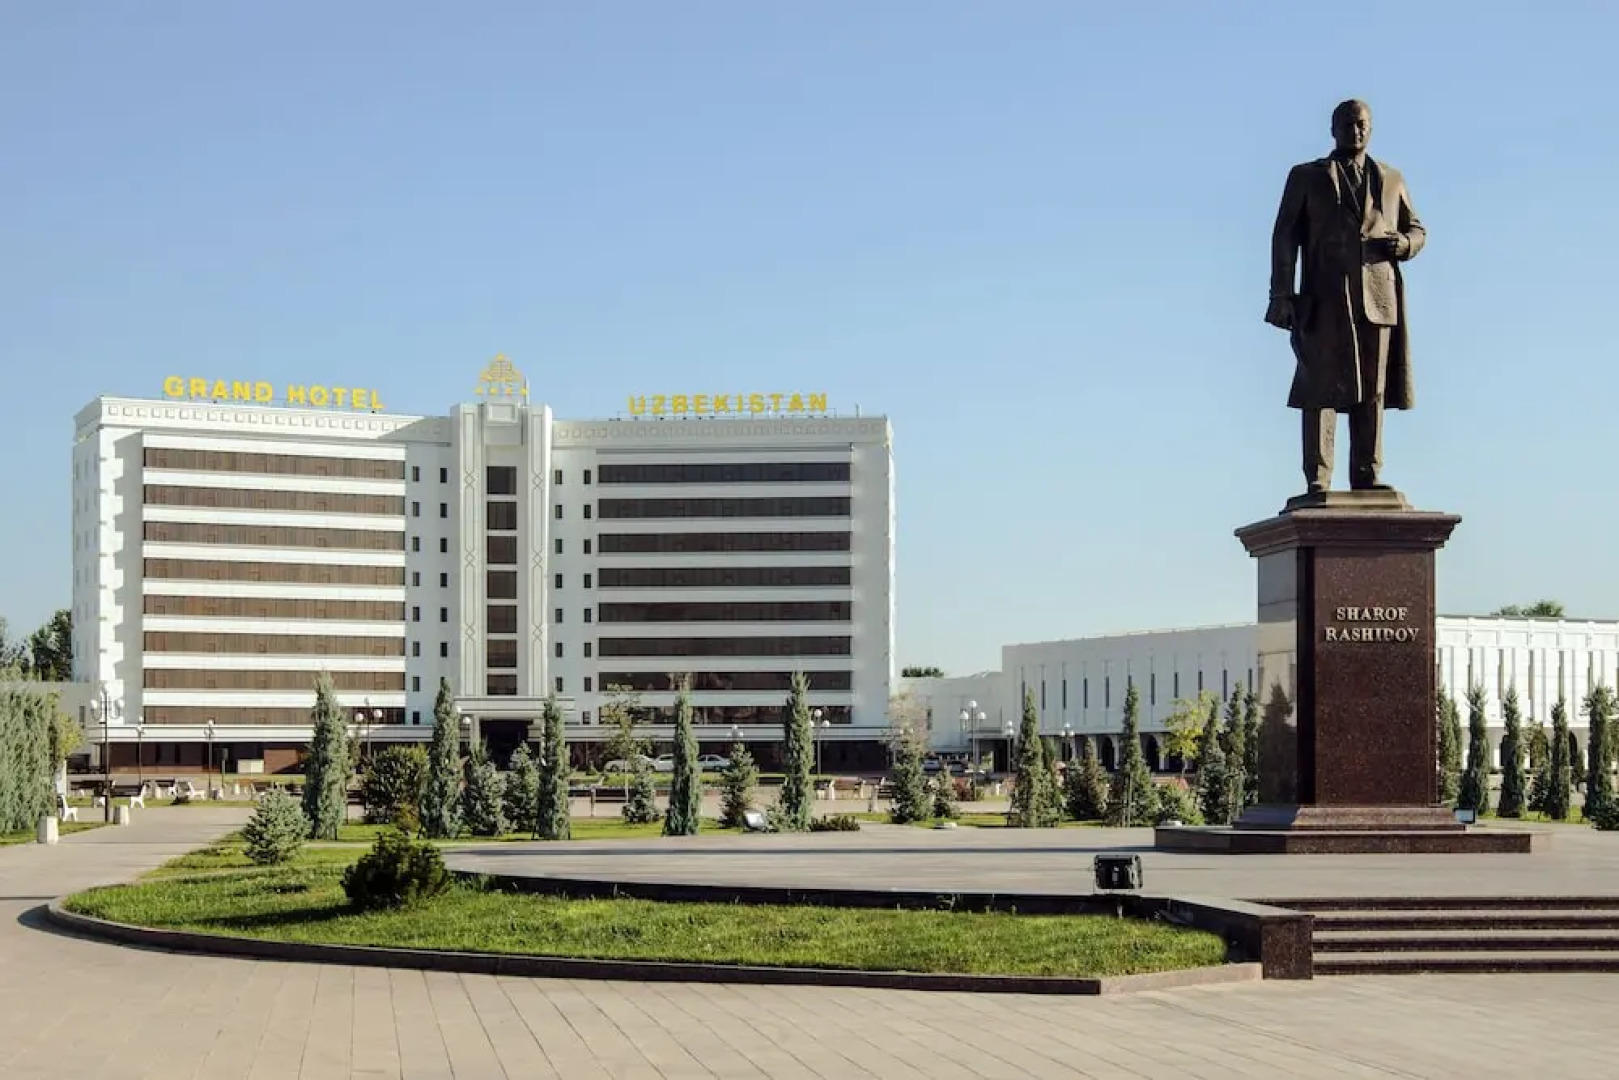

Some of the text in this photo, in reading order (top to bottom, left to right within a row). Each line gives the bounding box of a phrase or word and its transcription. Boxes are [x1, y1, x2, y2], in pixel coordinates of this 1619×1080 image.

[164, 376, 384, 409] GRAND HOTEL
[628, 393, 827, 414] UZBEKISTAN
[1335, 606, 1408, 621] SHAROF
